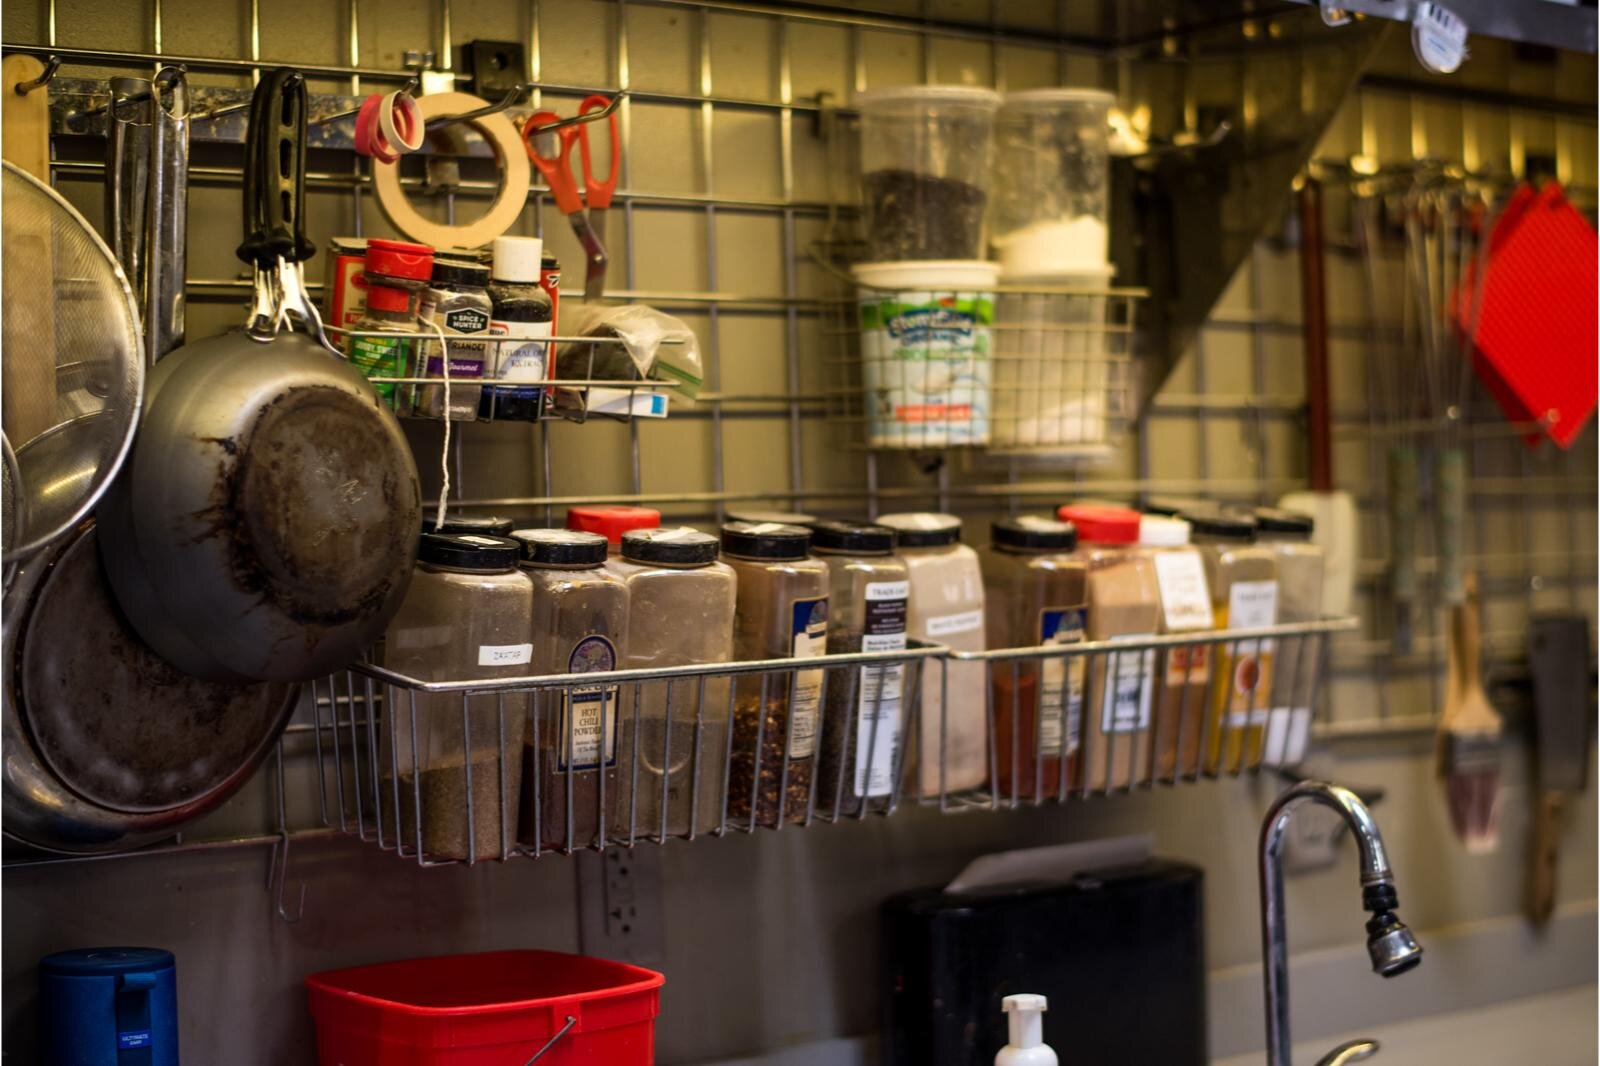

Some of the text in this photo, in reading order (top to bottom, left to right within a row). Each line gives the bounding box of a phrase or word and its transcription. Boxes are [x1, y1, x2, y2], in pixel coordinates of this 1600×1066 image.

[458, 314, 480, 323] SPICE
[452, 321, 483, 330] HUNTER
[441, 341, 485, 353] RIANDE
[581, 708, 597, 717] HOT
[574, 726, 602, 736] POWDE
